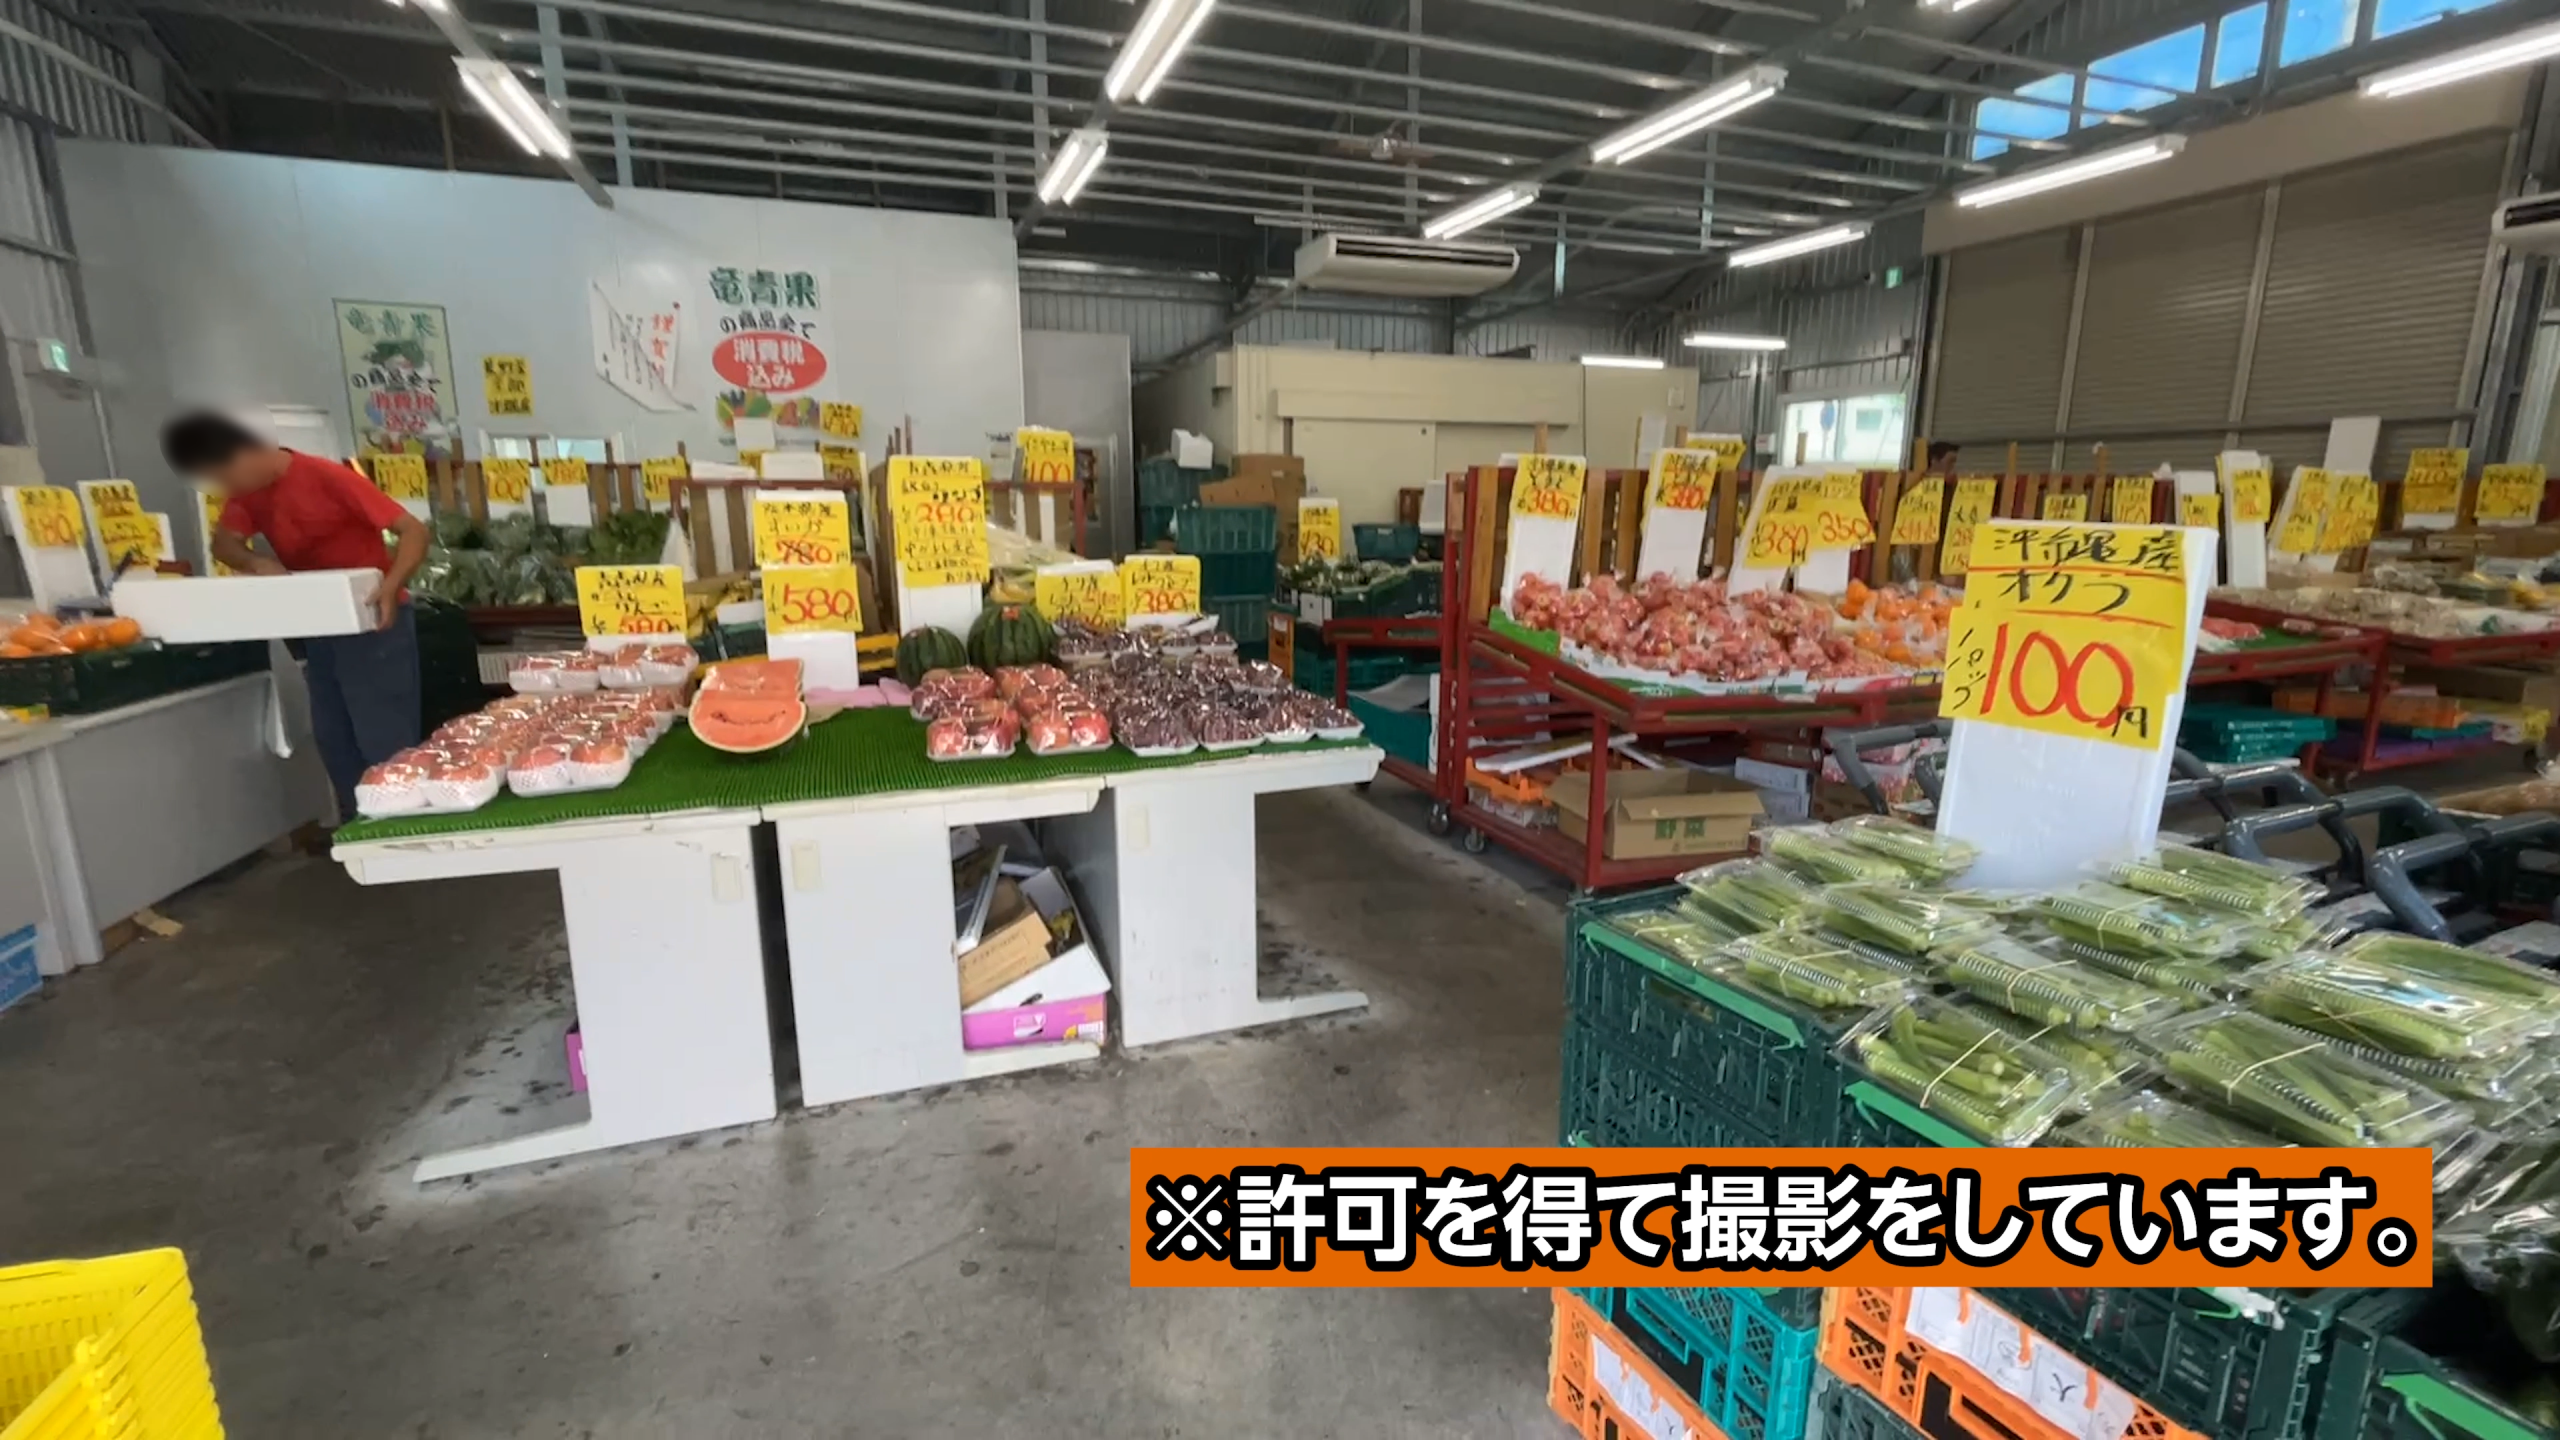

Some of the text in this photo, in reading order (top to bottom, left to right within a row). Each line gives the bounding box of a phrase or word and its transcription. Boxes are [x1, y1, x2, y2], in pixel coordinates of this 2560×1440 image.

[733, 336, 805, 366] 消費税
[746, 362, 796, 388] 込み
[1994, 526, 2179, 572] 沖縄産
[782, 583, 858, 624] 580円
[1997, 568, 2130, 615] オクラ
